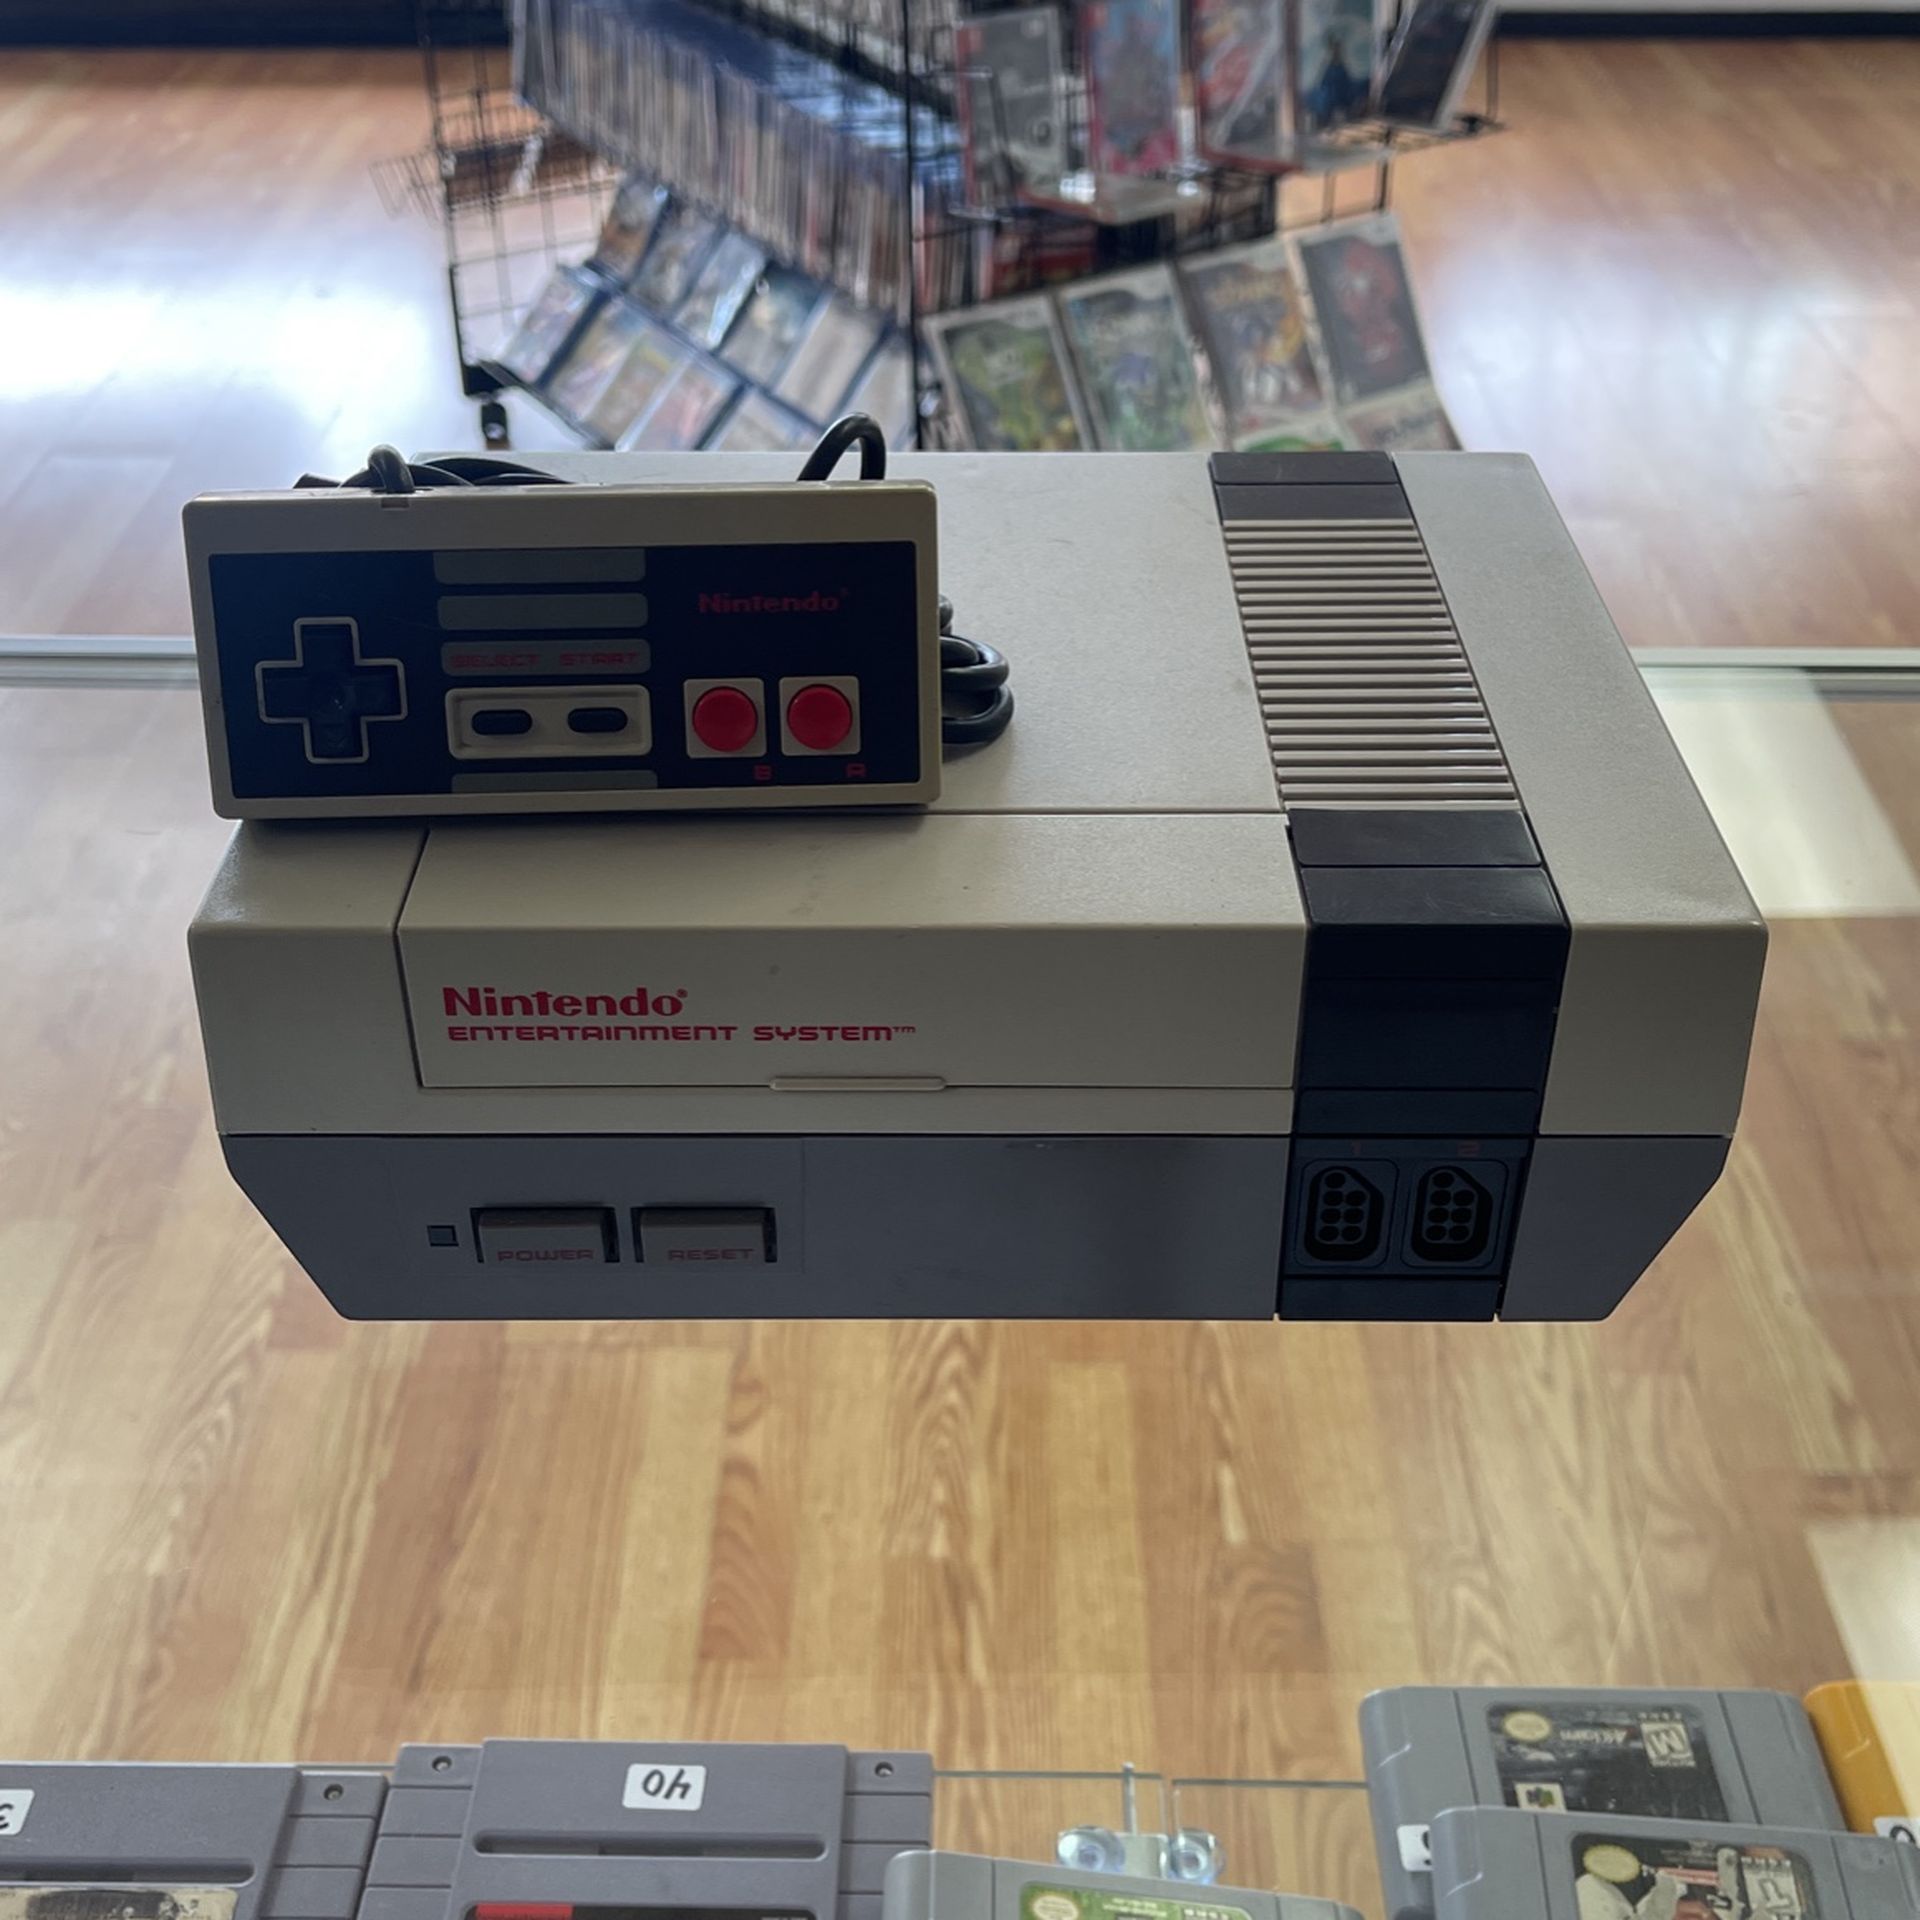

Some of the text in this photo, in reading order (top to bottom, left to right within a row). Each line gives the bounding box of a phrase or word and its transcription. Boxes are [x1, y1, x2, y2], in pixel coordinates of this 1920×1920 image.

[452, 651, 639, 669] SELECT START
[753, 763, 866, 780] B A
[447, 1025, 738, 1042] ENTERTAINMENT
[497, 1247, 755, 1262] POWER RESET
[641, 1769, 692, 1801] 40
